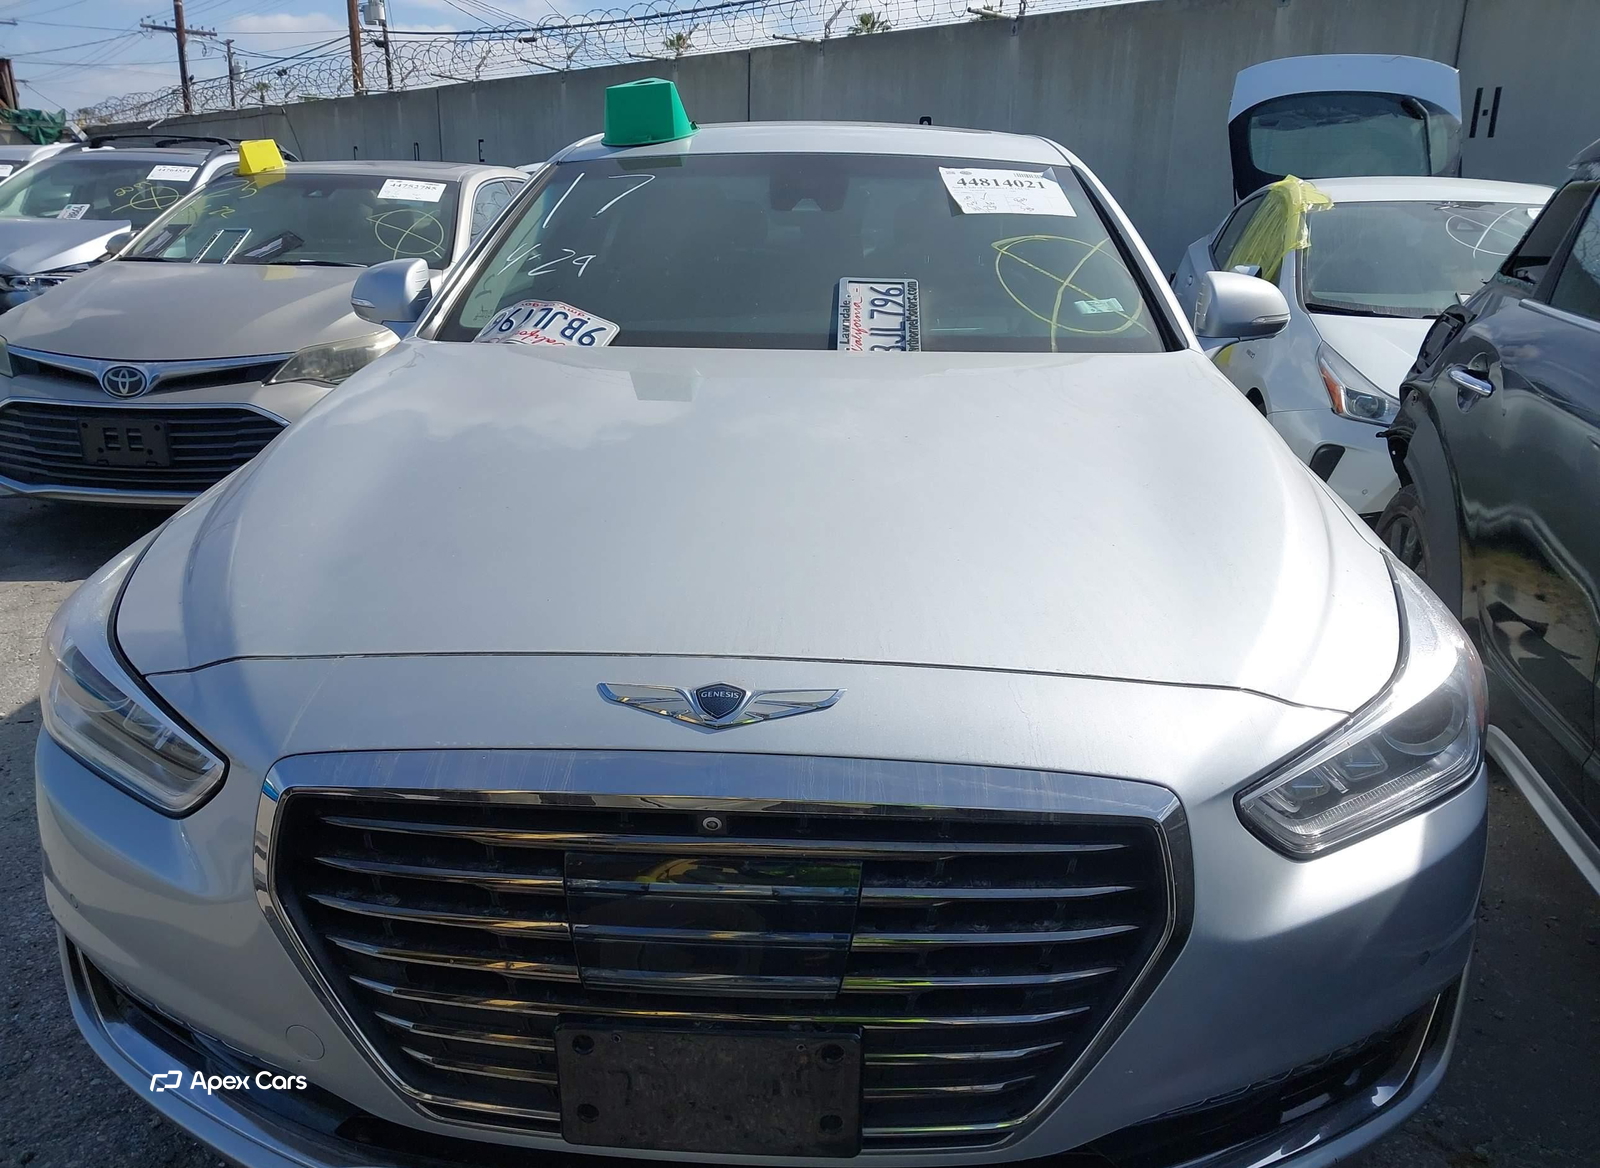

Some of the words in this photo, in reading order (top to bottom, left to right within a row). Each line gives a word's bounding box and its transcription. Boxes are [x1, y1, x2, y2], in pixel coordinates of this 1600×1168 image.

[956, 177, 1047, 190] 44814021
[839, 300, 851, 345] Lawndale
[701, 691, 739, 699] GENESIS
